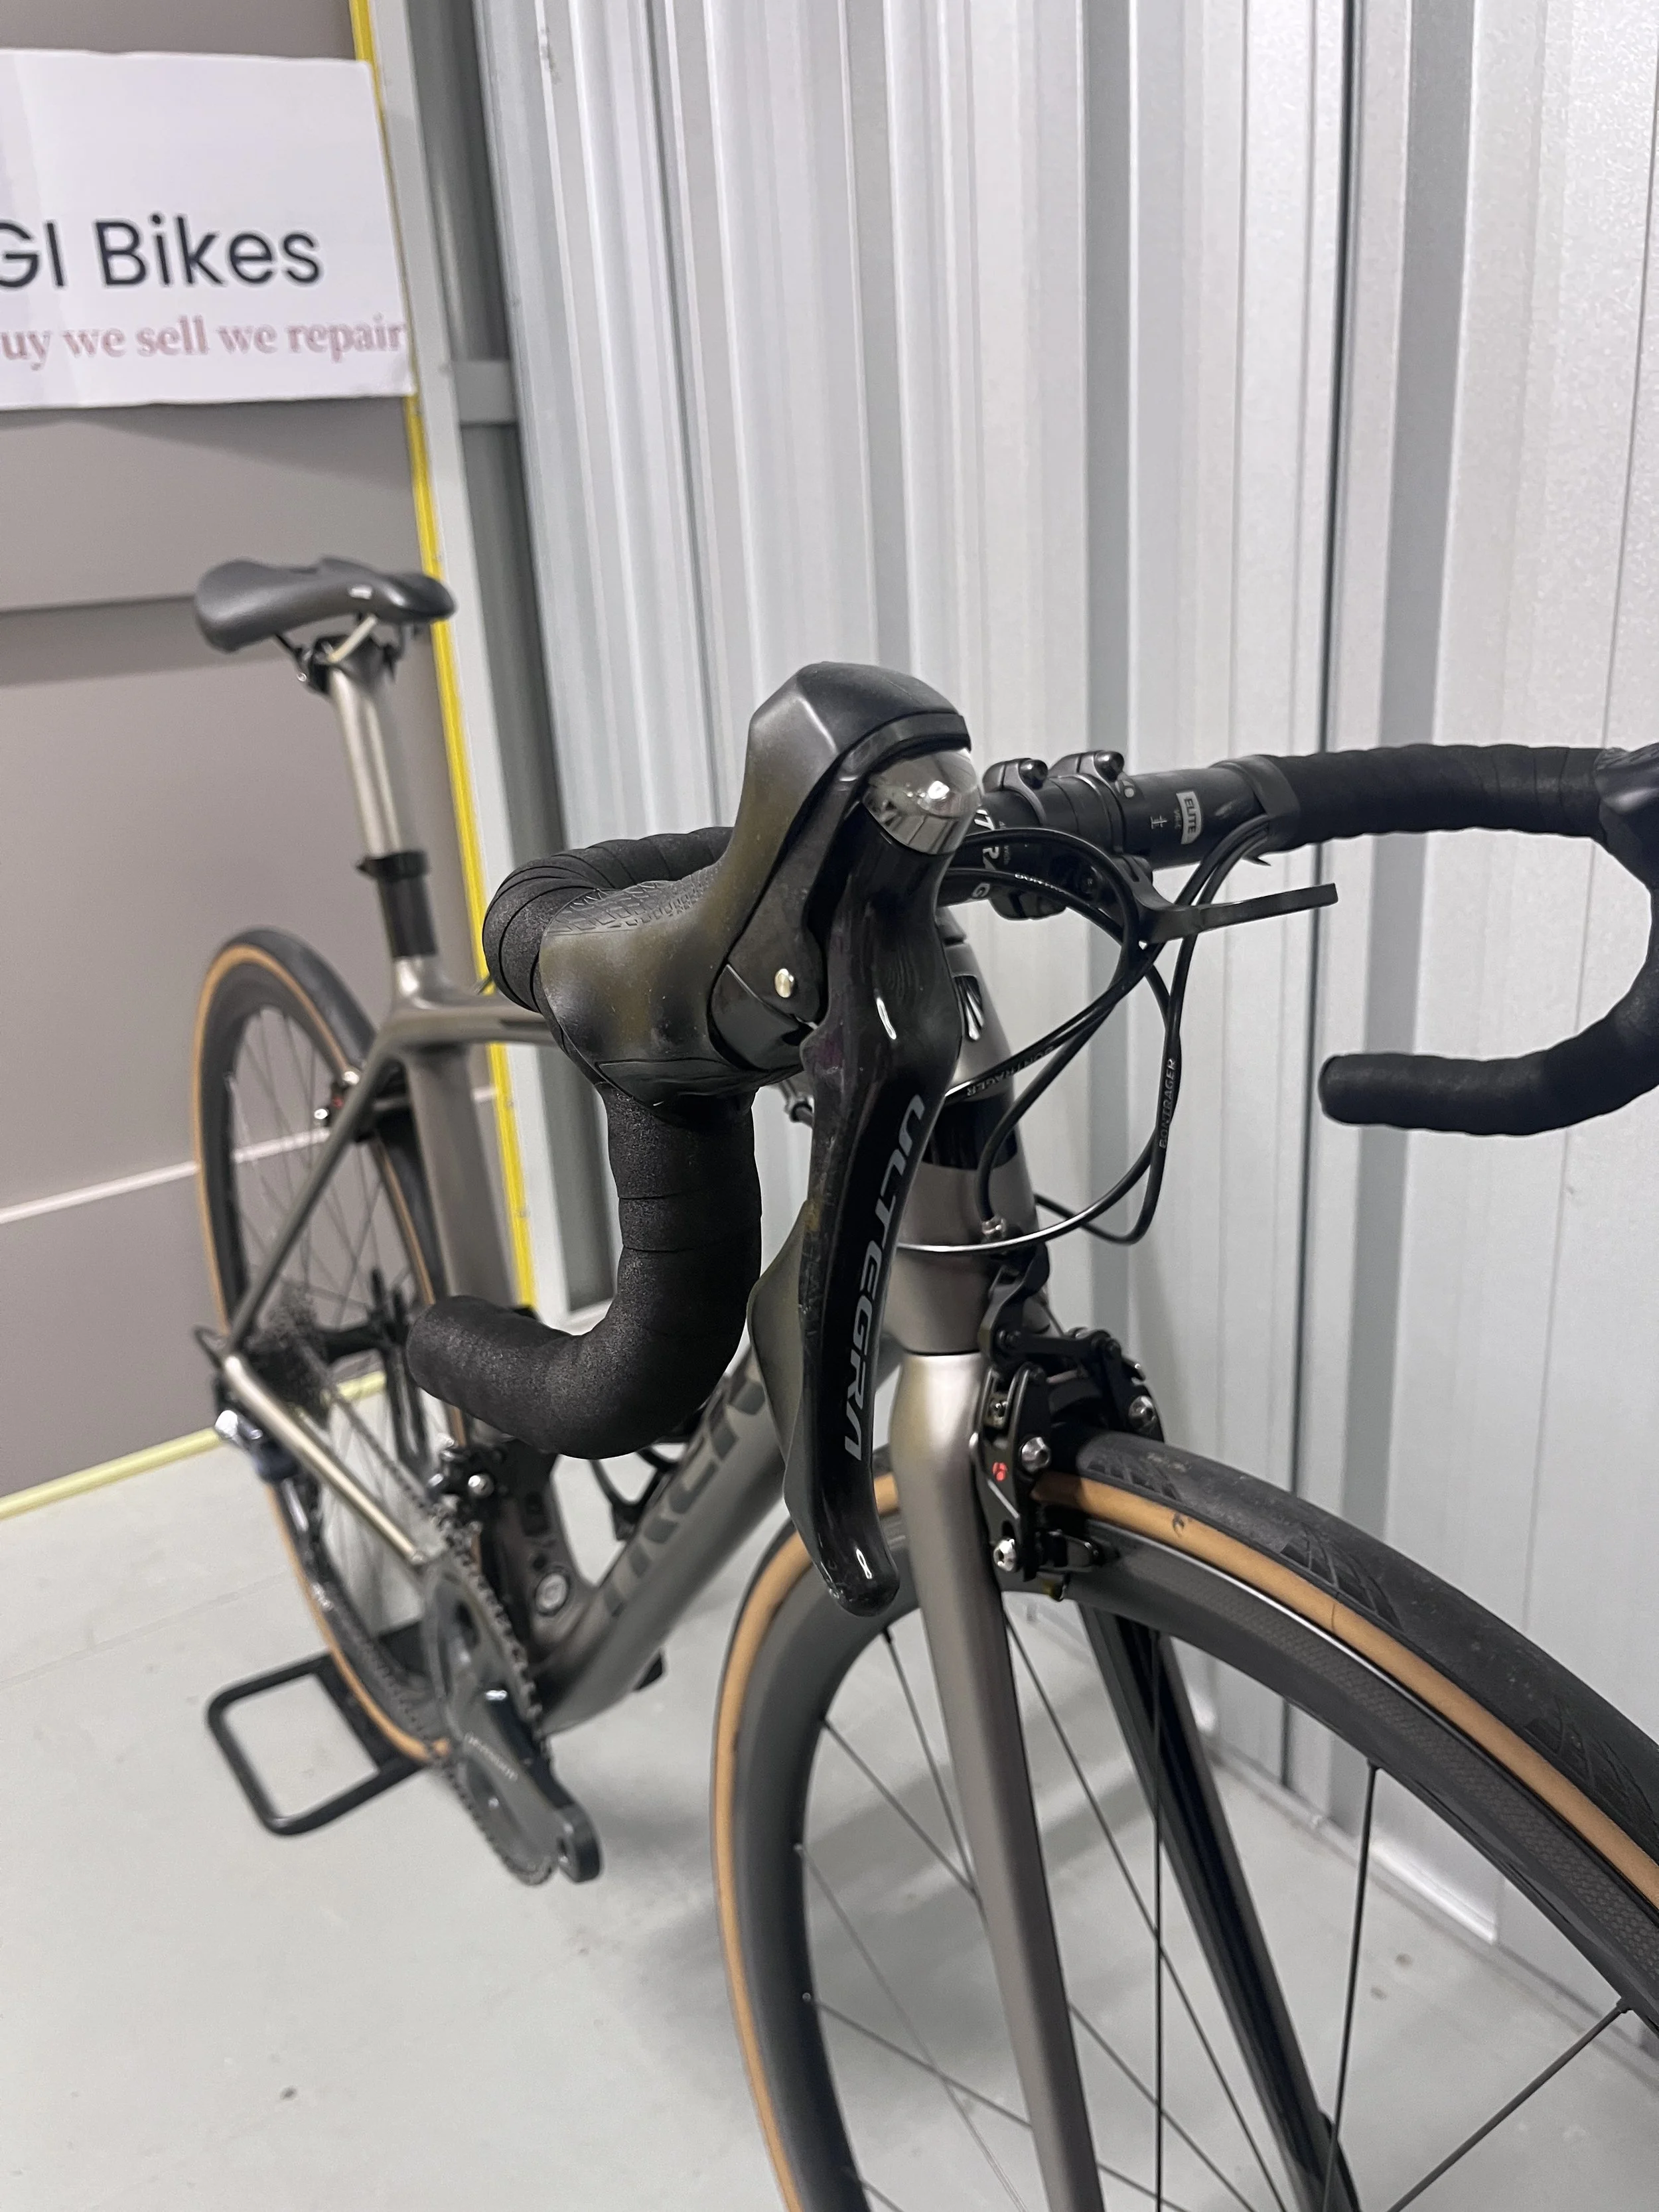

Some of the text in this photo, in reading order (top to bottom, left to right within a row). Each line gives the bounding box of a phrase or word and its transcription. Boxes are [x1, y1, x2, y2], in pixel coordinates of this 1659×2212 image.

[95, 214, 321, 285] Bikes
[64, 326, 126, 356] we
[136, 316, 208, 356] sell
[219, 322, 279, 353] we
[287, 314, 407, 361] repair
[1185, 798, 1196, 834] ELITE
[1159, 1059, 1176, 1148] BONTRAGER
[845, 1094, 925, 1461] ULTEGRA
